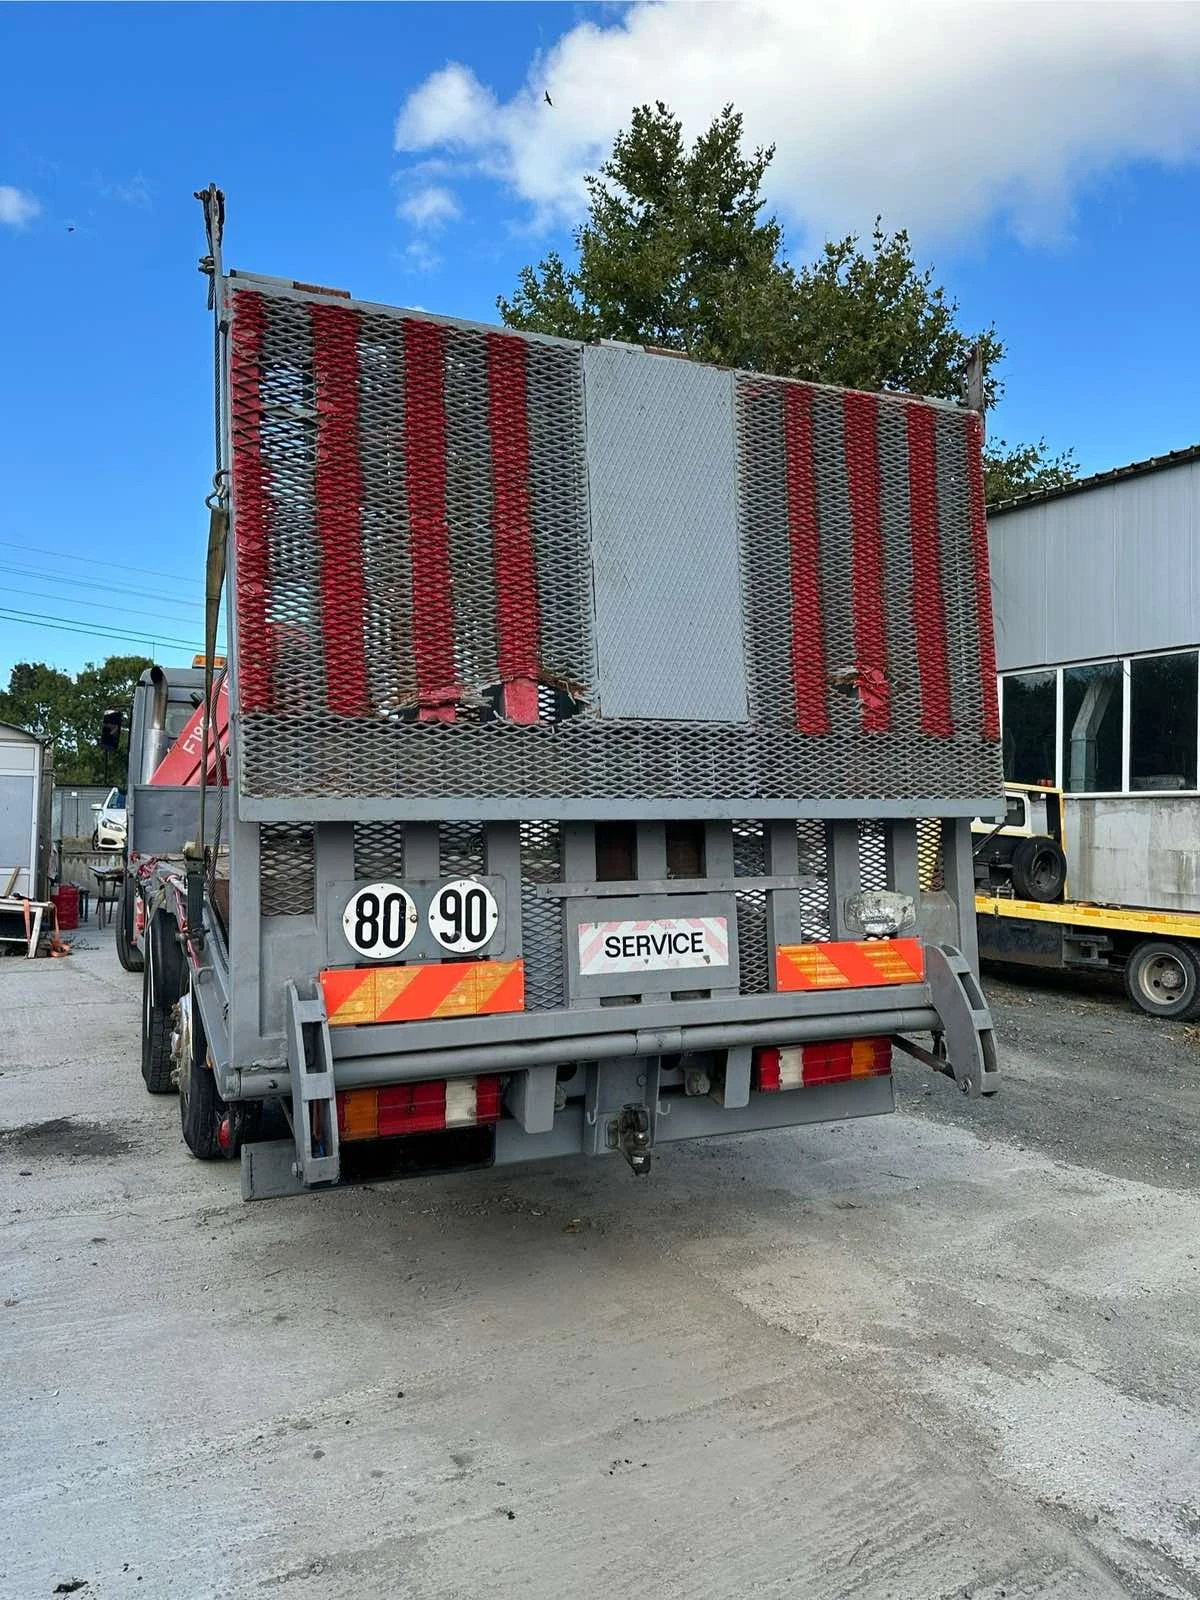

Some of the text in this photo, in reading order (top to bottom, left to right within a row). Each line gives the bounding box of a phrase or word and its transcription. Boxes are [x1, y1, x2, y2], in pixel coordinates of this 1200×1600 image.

[355, 892, 406, 949] 80
[439, 888, 487, 943] 90
[604, 931, 704, 958] SERVICE
